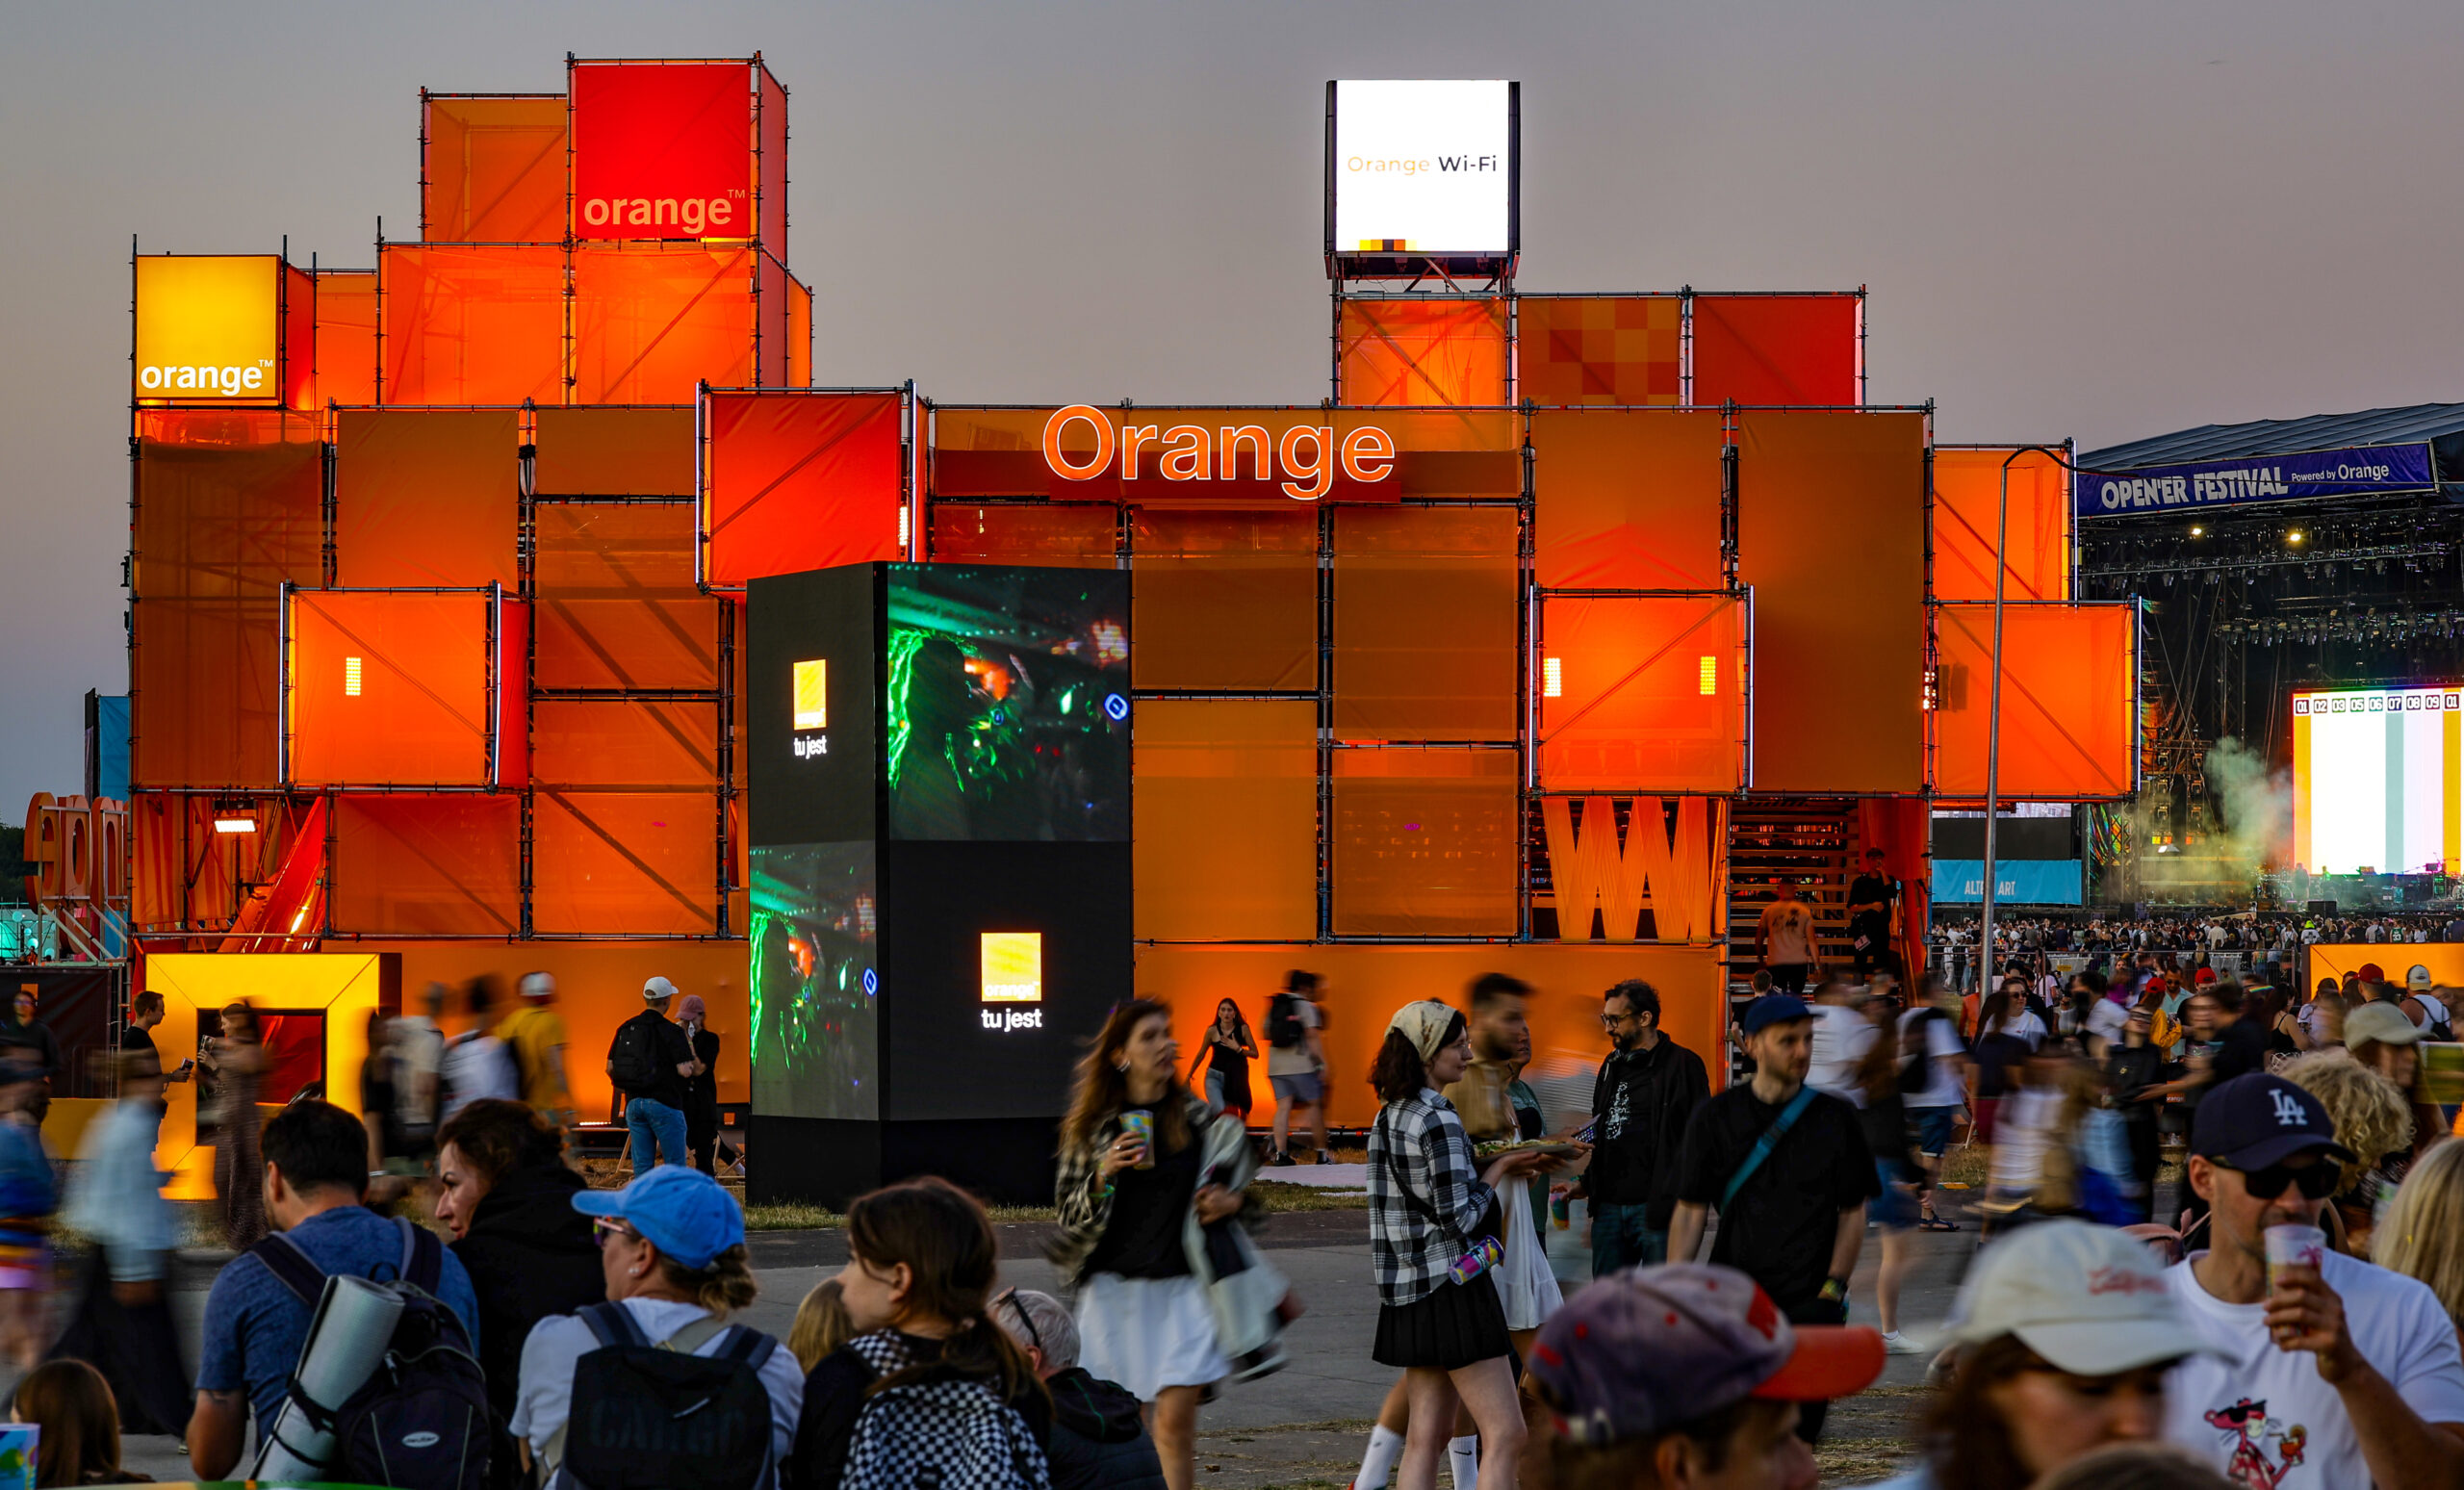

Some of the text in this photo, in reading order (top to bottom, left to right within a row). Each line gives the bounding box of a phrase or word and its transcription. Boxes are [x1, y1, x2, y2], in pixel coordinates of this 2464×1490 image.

[1348, 155, 1497, 176] Orange Wi-Fi
[1042, 404, 1396, 501] Orange
[2101, 464, 2389, 509] OPEN'ER FESTIVAL Powered by Orange
[2297, 696, 2458, 713] 01 02 03 05 06 07 08 09 01
[793, 734, 827, 759] tu jest
[1964, 880, 2016, 896] ALTE ART
[981, 1007, 1042, 1033] tu jest
[2268, 1089, 2308, 1126] LA
